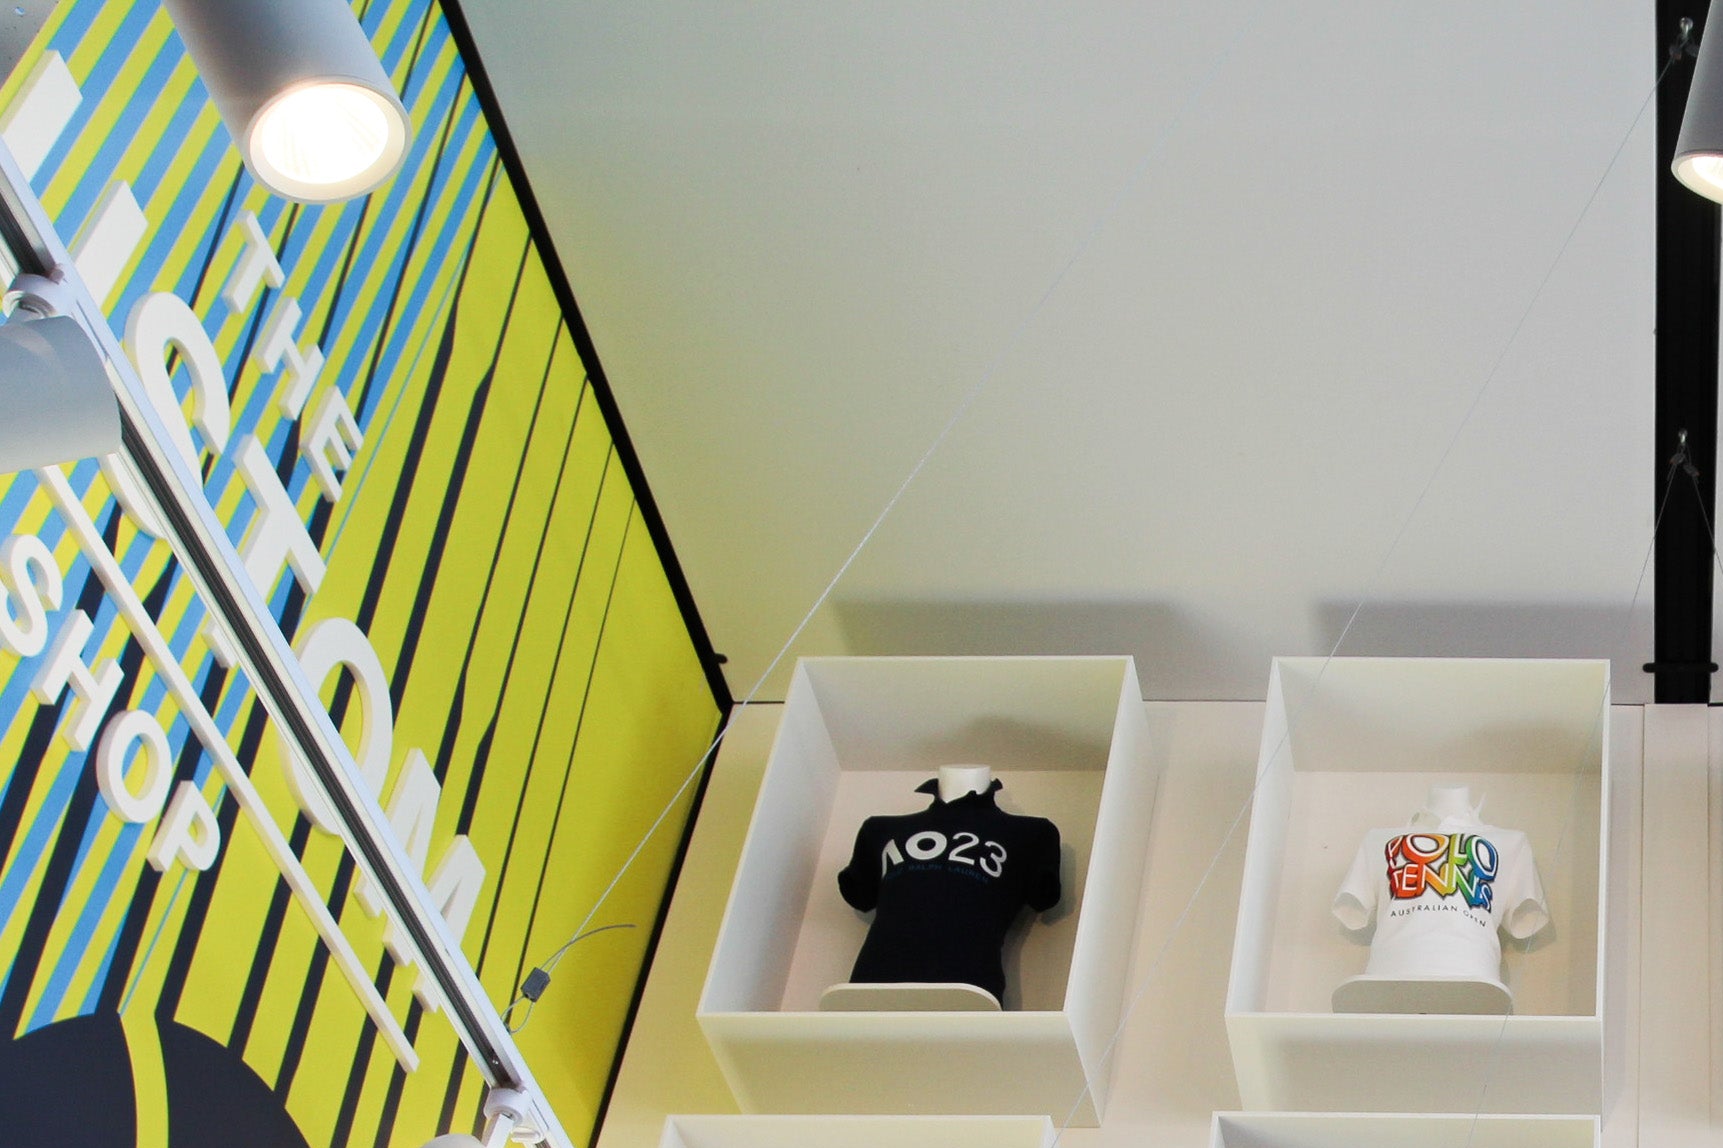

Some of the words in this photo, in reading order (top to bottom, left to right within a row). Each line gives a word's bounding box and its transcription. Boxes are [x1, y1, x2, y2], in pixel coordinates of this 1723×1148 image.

[221, 208, 364, 503] THE
[0, 533, 221, 872] SHOP
[1385, 833, 1499, 882] POLO
[1390, 904, 1458, 918] AUSTRALIAN
